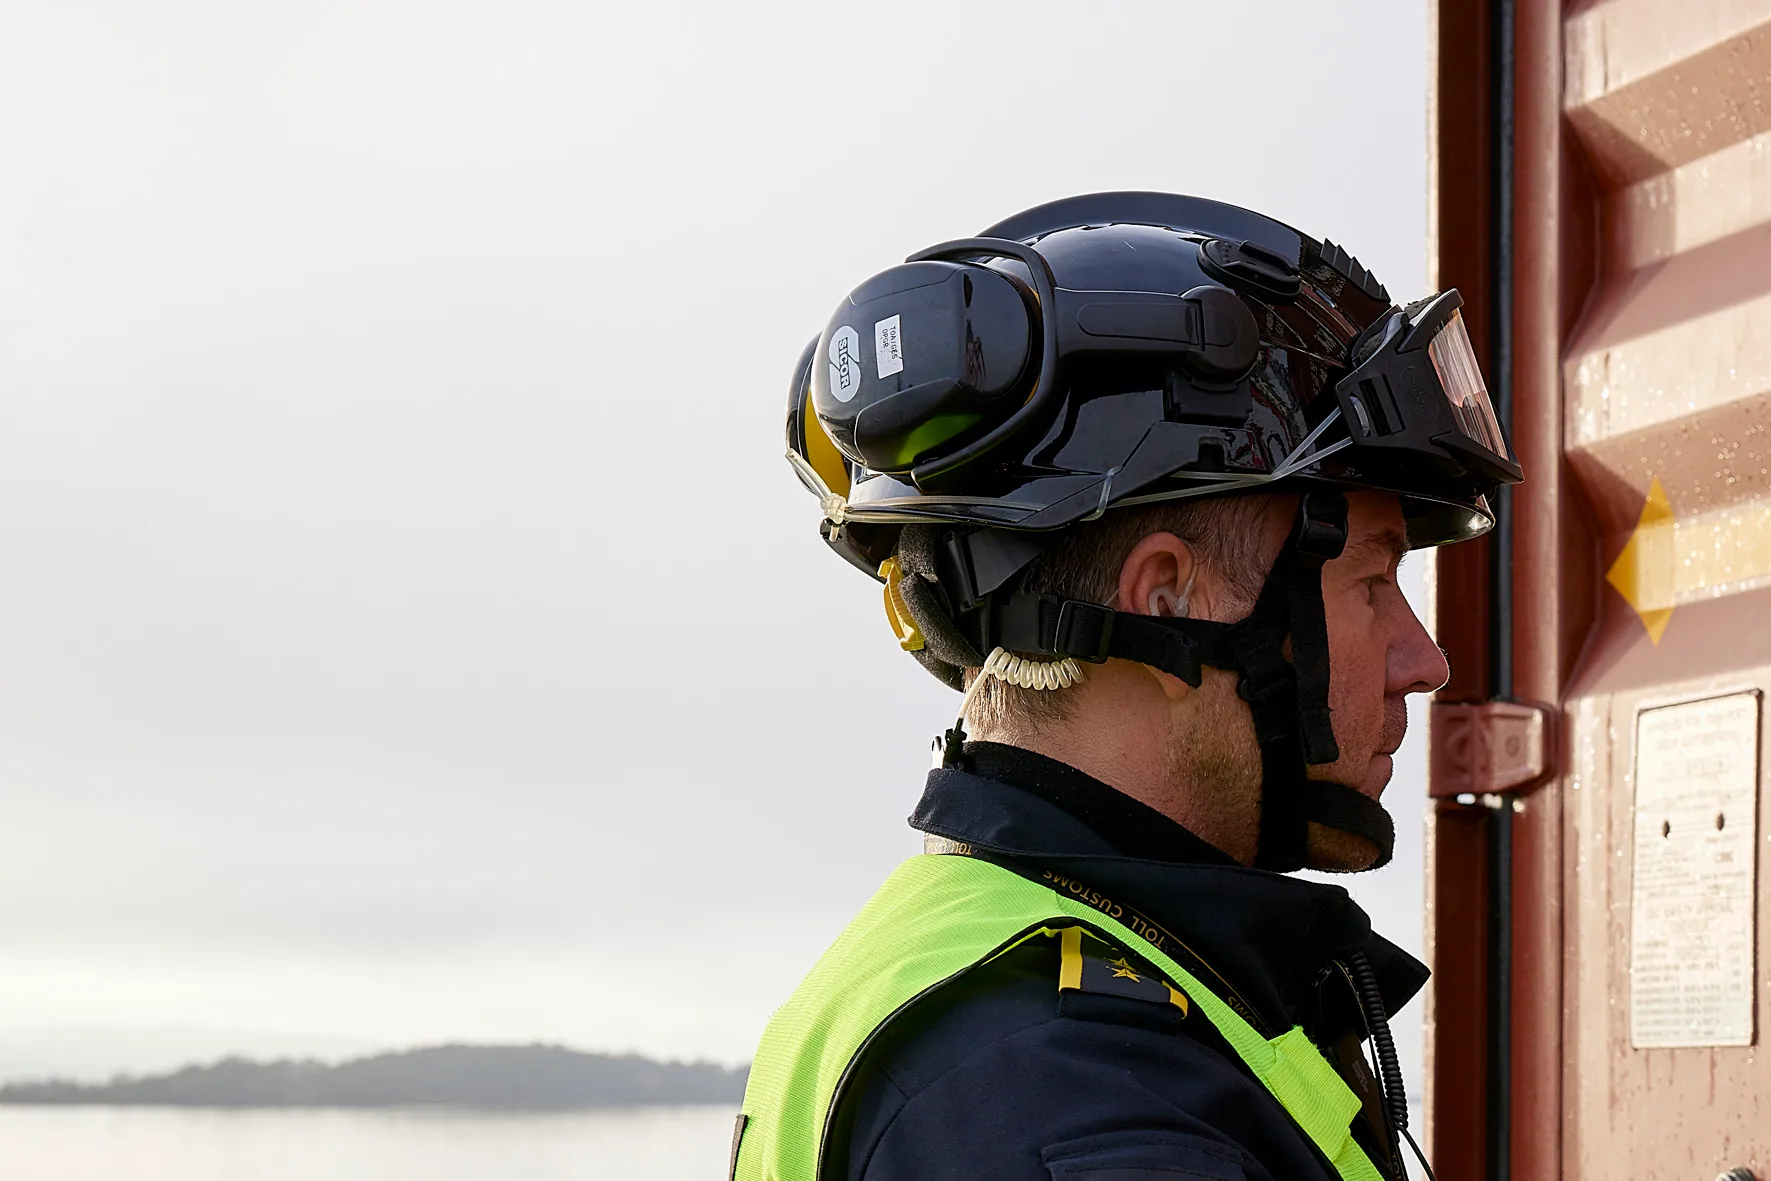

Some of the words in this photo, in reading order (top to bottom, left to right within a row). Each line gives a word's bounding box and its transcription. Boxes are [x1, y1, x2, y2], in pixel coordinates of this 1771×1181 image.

[838, 337, 851, 389] SICOR
[1043, 870, 1123, 918] CUSTOMS
[1131, 915, 1165, 949] TOLL
